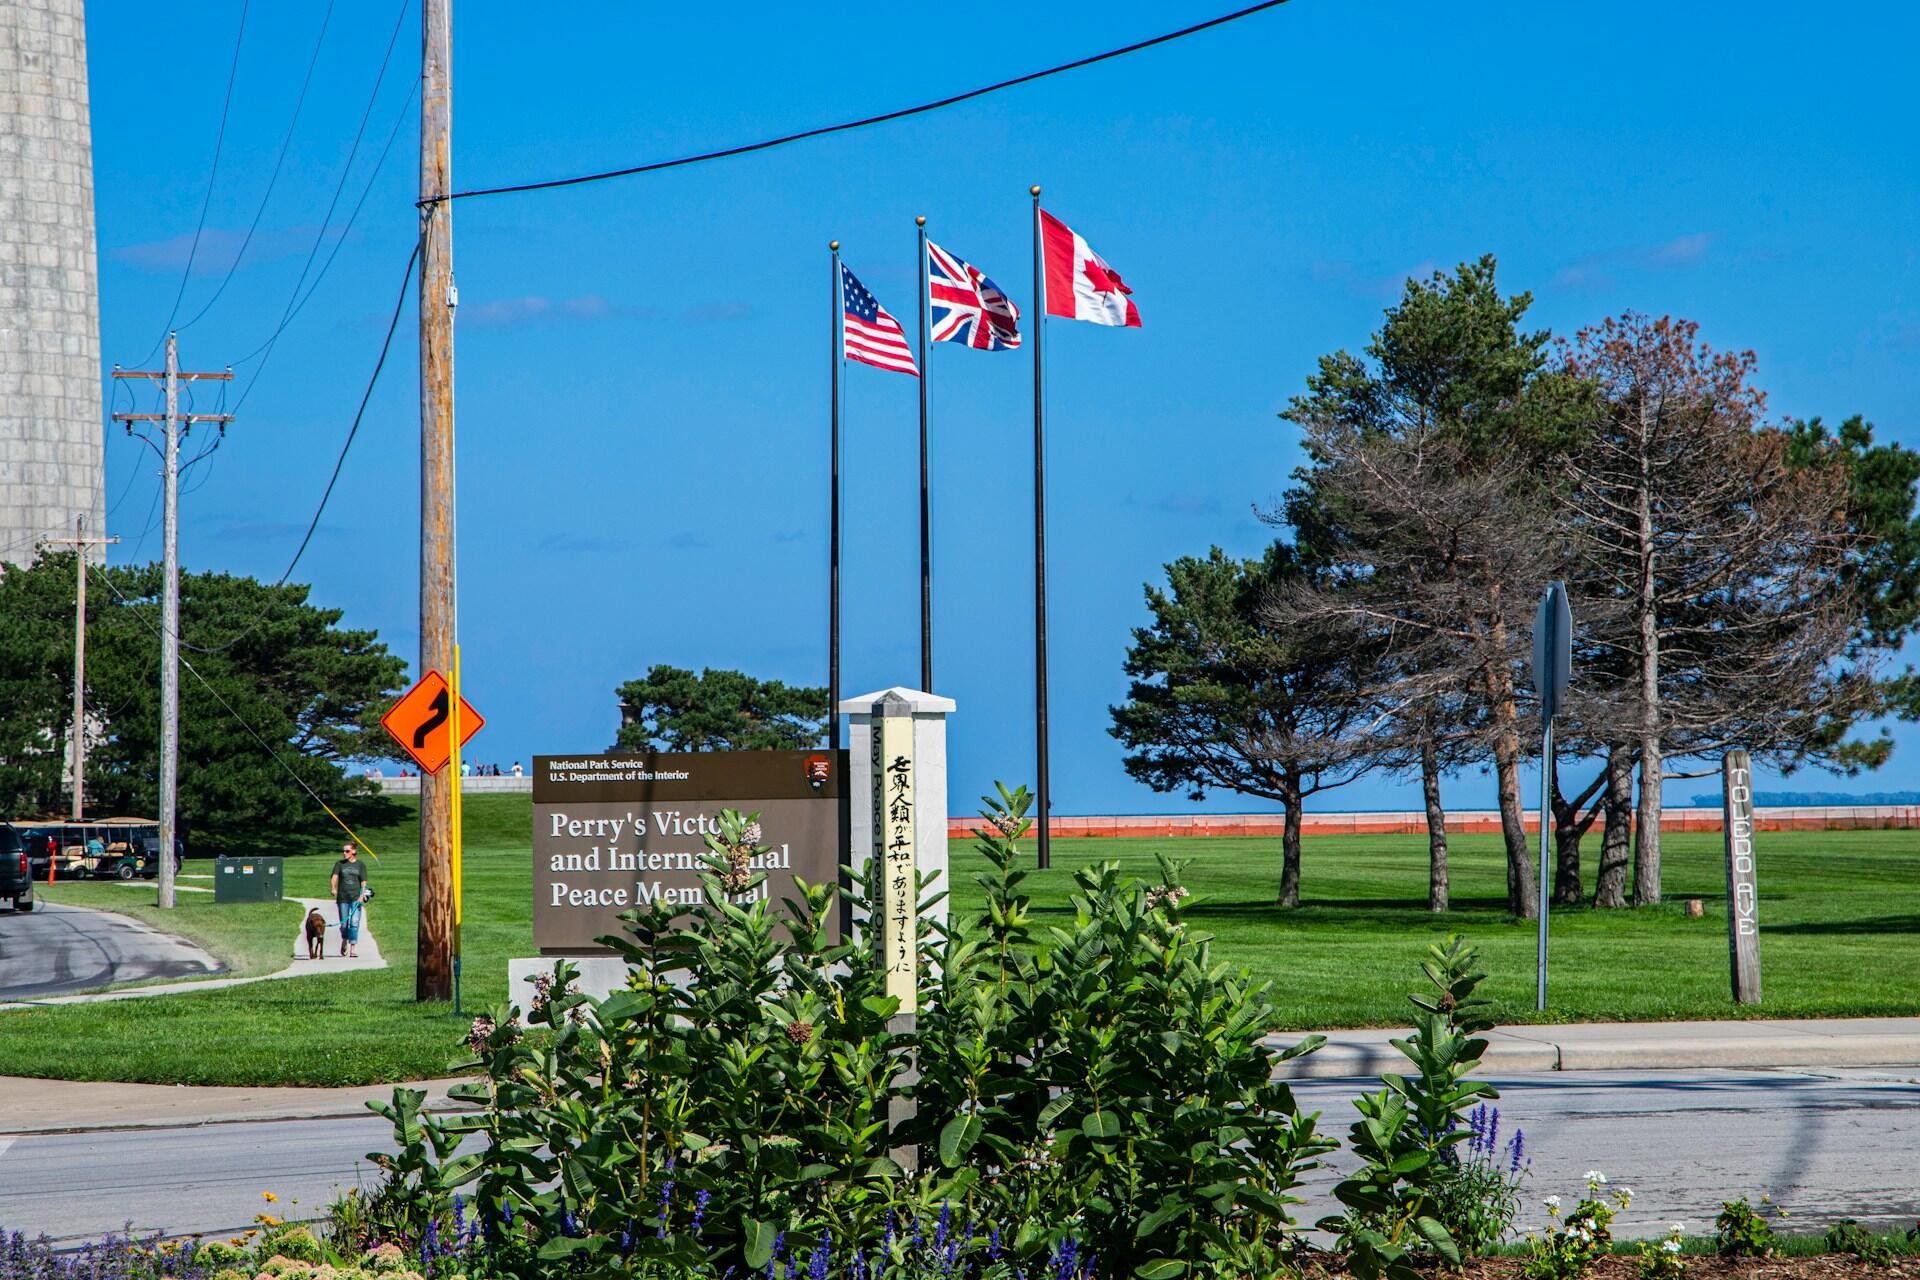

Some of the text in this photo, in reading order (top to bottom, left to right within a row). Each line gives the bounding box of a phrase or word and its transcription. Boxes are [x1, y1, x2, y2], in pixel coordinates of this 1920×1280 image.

[872, 726, 882, 768] May
[549, 759, 643, 770] National Park Service
[550, 770, 689, 783] U.S. Department of the Interior
[873, 774, 882, 836] Peace
[550, 811, 747, 844] Perry's Victo
[550, 843, 791, 872] and Internanal
[887, 755, 912, 972] 世界人類が平和でありますように
[1731, 768, 1755, 935] TOLEDO AVE
[874, 843, 884, 907] Prevail
[550, 879, 769, 907] Peace Memial
[874, 913, 884, 942] On
